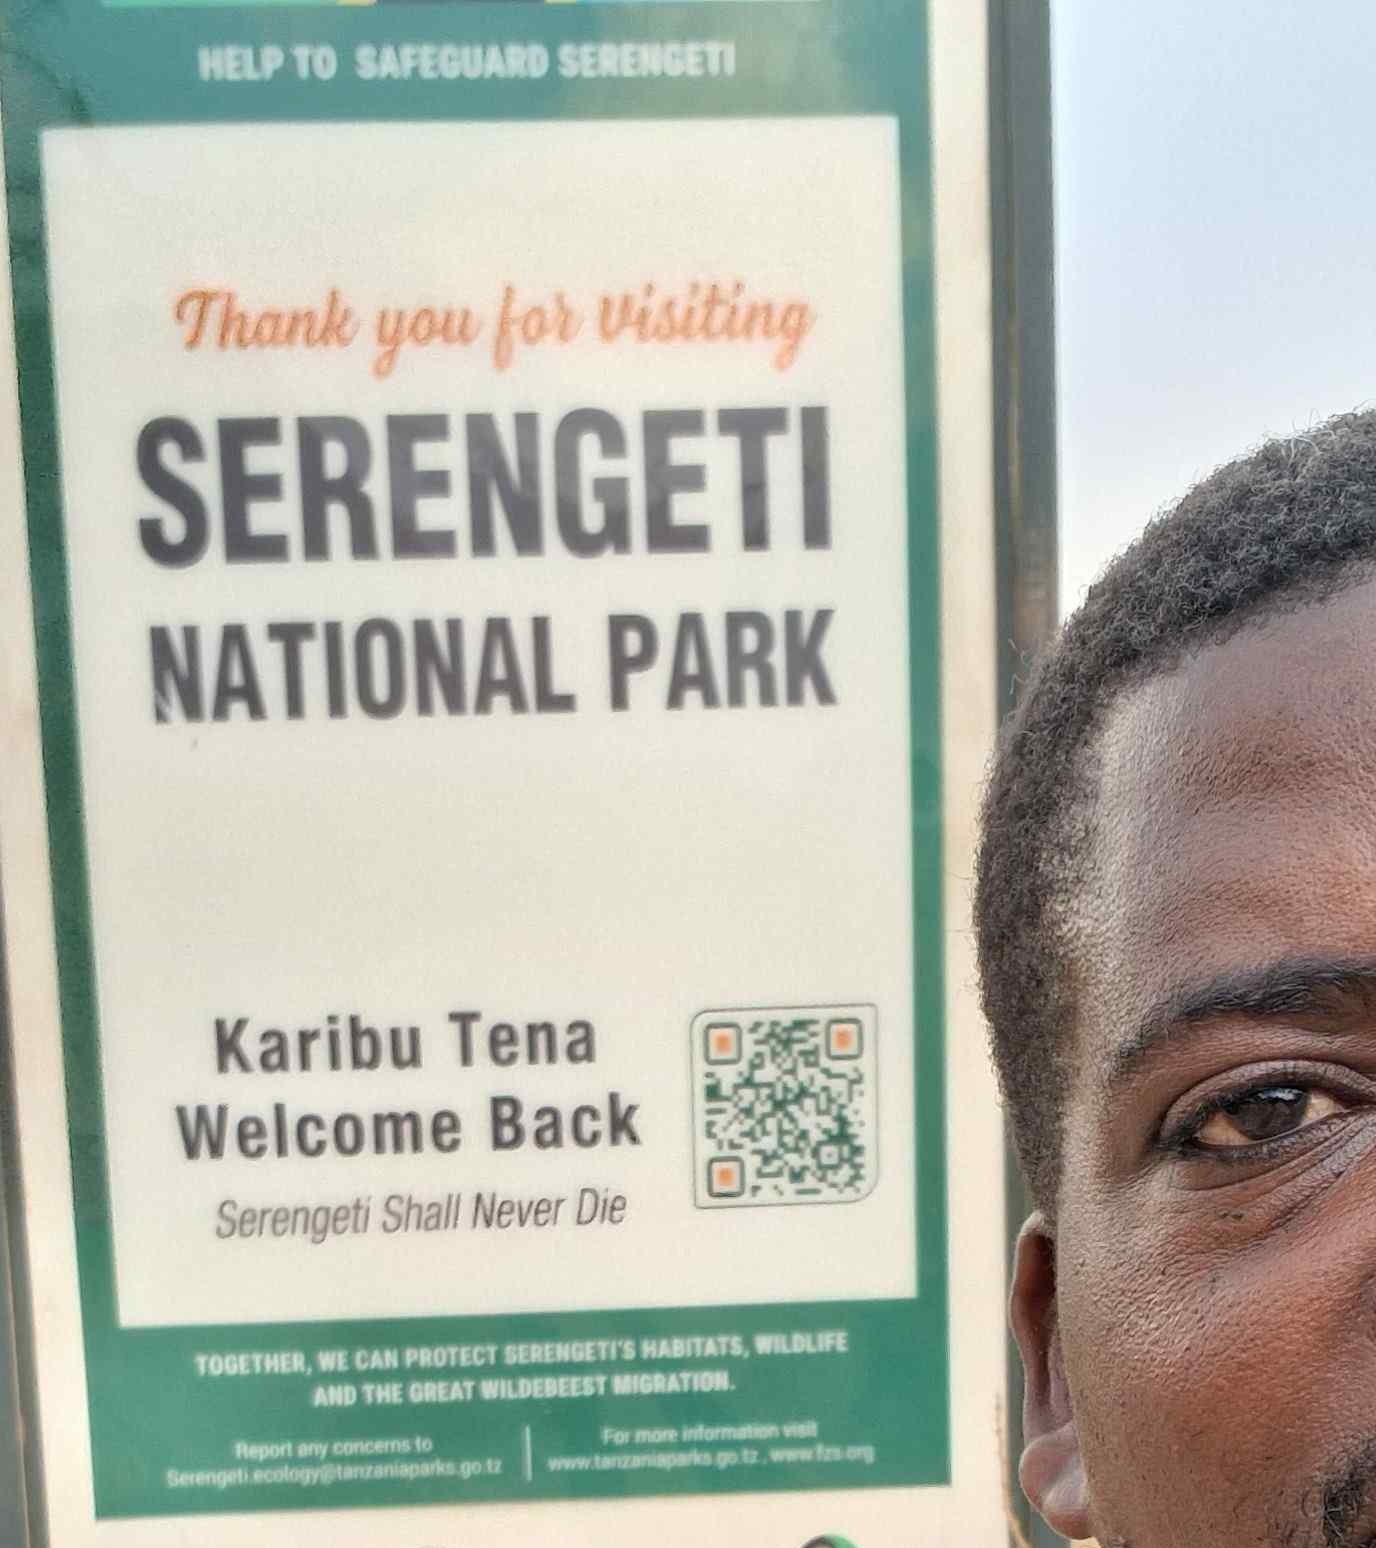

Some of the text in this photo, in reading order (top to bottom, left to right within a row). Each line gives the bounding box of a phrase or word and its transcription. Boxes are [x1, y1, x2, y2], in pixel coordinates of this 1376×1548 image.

[199, 40, 736, 81] HELP TO SAFEGUARD SERENGETI
[173, 286, 358, 352] Thank
[376, 309, 481, 377] you
[492, 286, 575, 370] for
[136, 406, 833, 569] SERENGETI
[148, 607, 839, 725] NATIONAL PARK
[212, 1011, 599, 1075] Karibu Tena
[175, 1091, 643, 1161] Welcome Back
[215, 1186, 628, 1245] Serengeti Shall Never Die
[194, 1331, 849, 1376] TOGETHER, WE CAN PROTECT SERENGETI'S HABITATS, WILDLIFE
[313, 1370, 736, 1408] AND THE GREAT WILDEBEEST MIGRATION.
[232, 1436, 433, 1462] Report any concerns to
[600, 1419, 818, 1445] For more information visit
